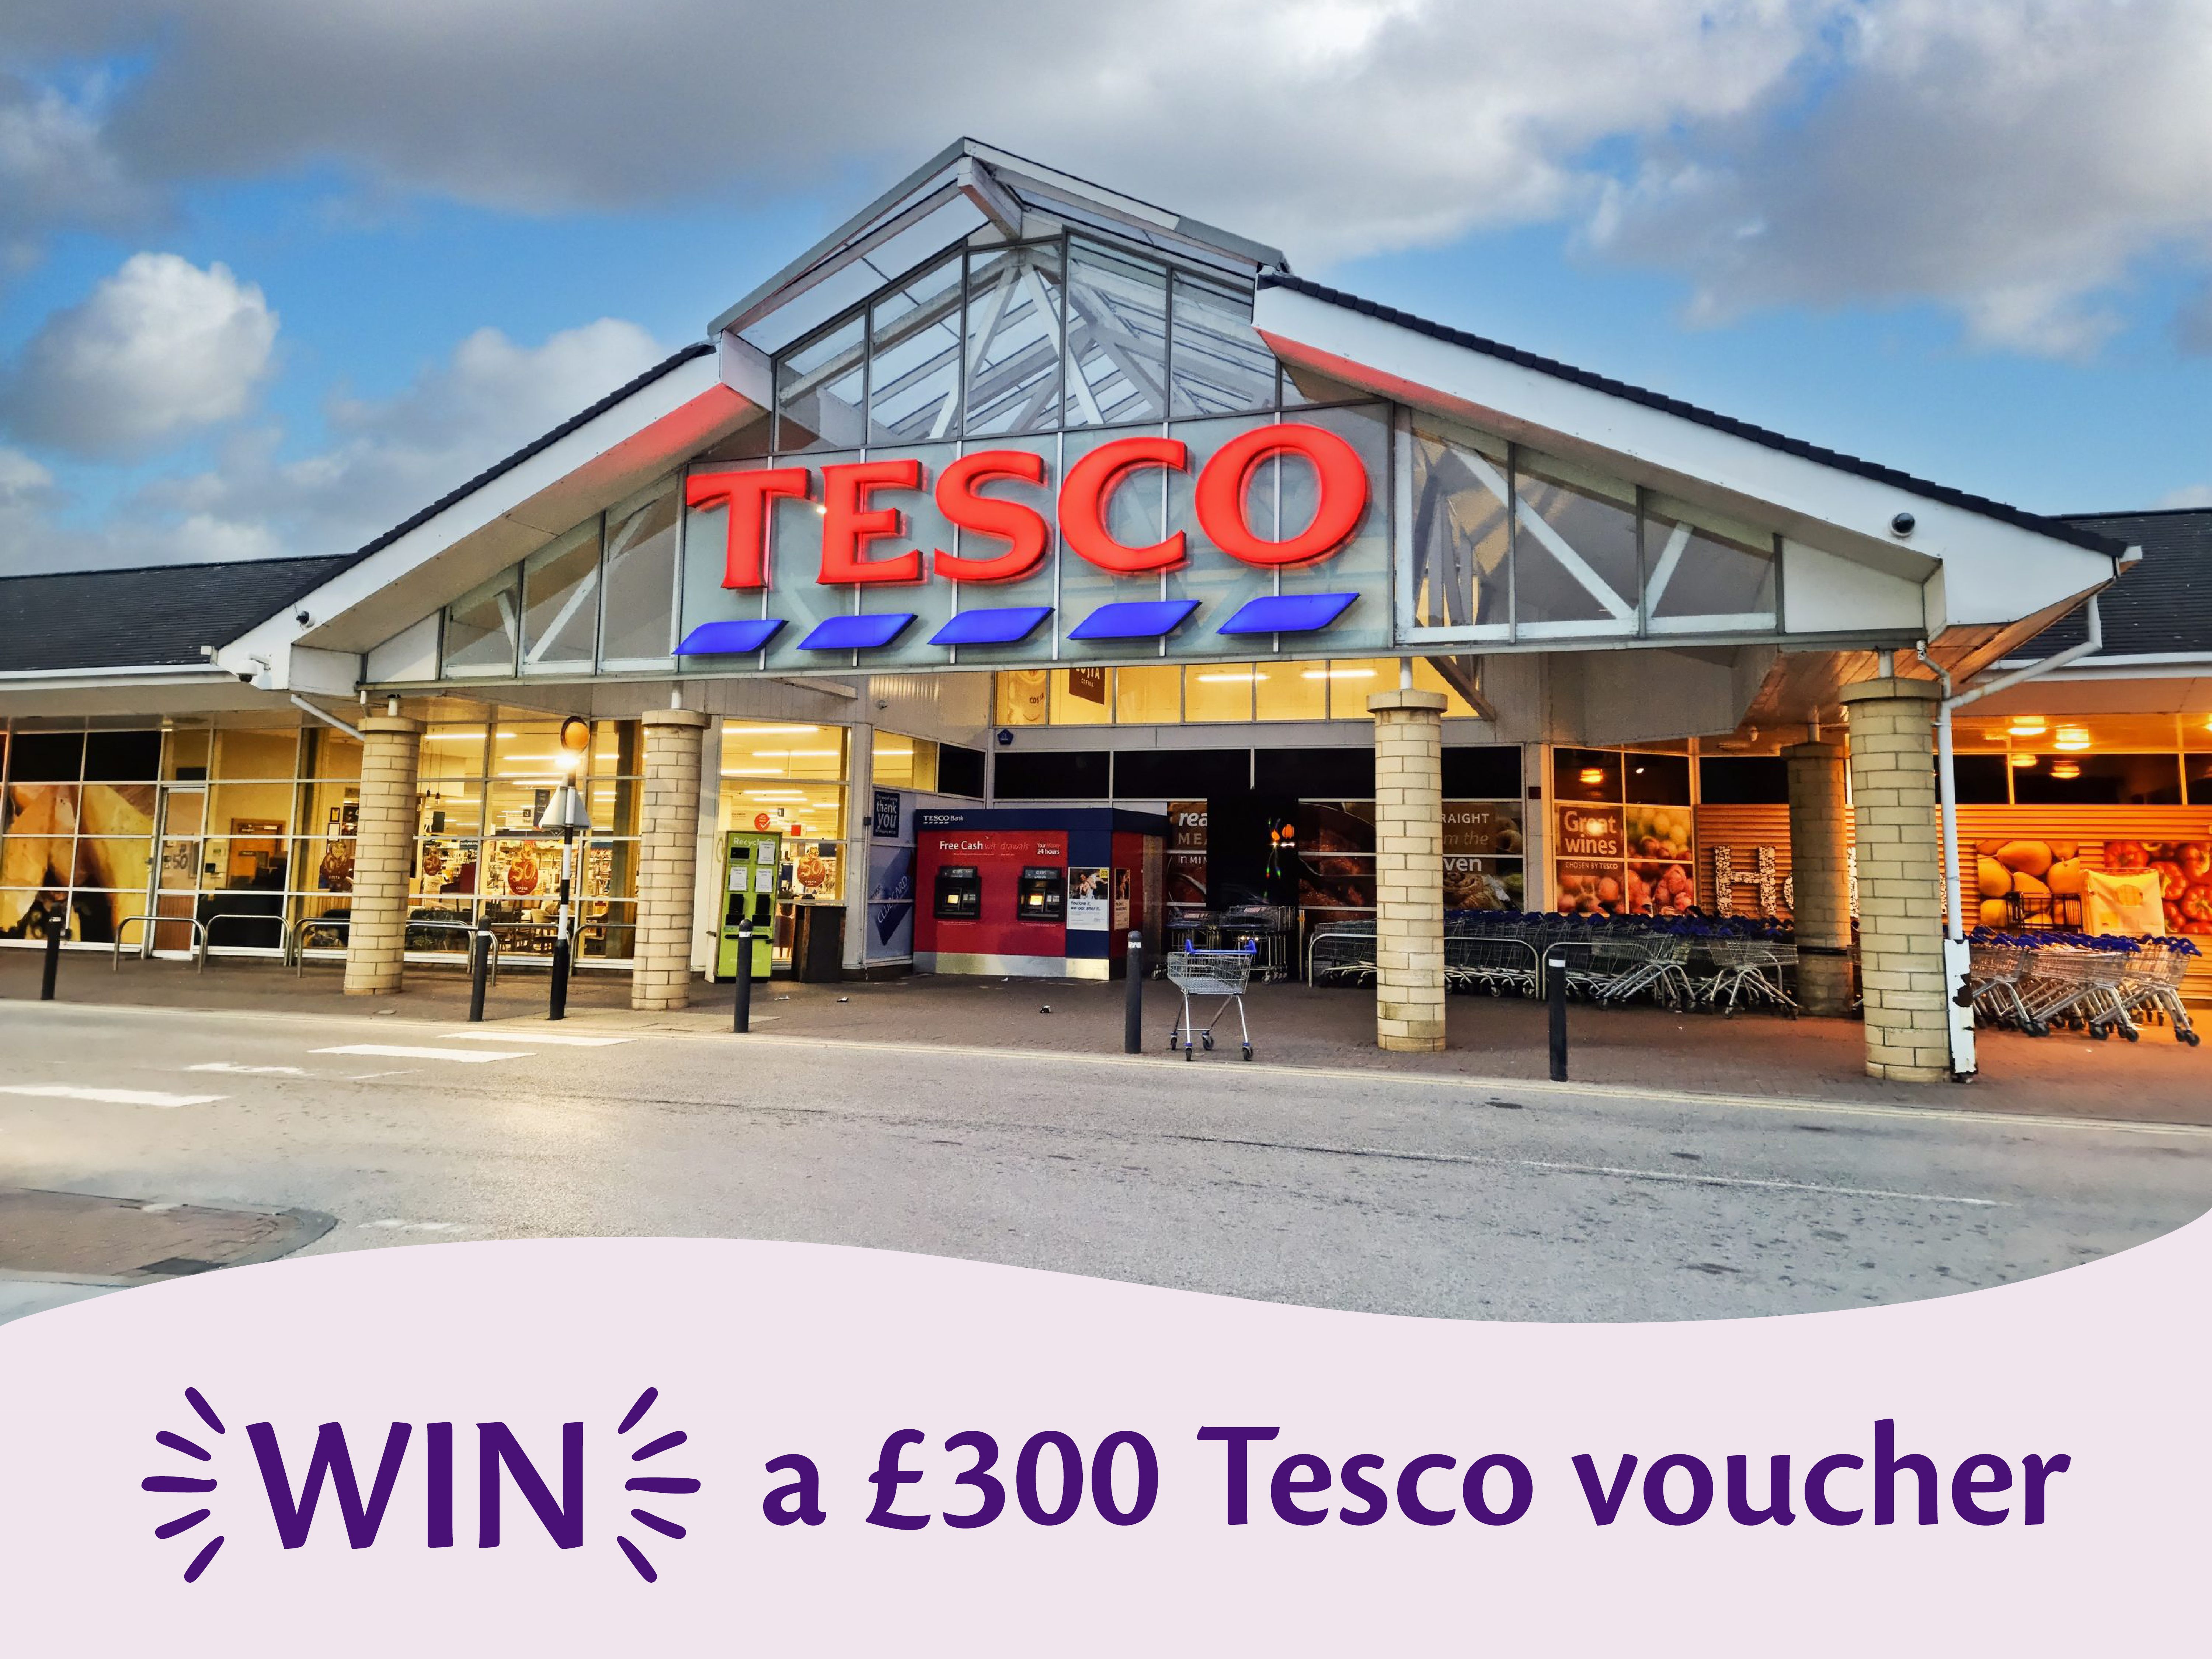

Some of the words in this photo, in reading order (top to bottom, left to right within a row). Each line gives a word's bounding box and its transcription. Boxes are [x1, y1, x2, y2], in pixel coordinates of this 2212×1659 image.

[686, 423, 1368, 590] TESCO
[877, 800, 896, 814] thank
[877, 813, 897, 829] you
[733, 837, 759, 847] Recycl
[1178, 833, 1207, 845] ME
[1464, 830, 1489, 845] the
[1565, 834, 1617, 854] wines
[940, 841, 959, 850] Free
[961, 841, 983, 850] Cash
[985, 842, 1029, 850] witdrawals
[511, 858, 536, 882] 50
[799, 857, 823, 877] 50
